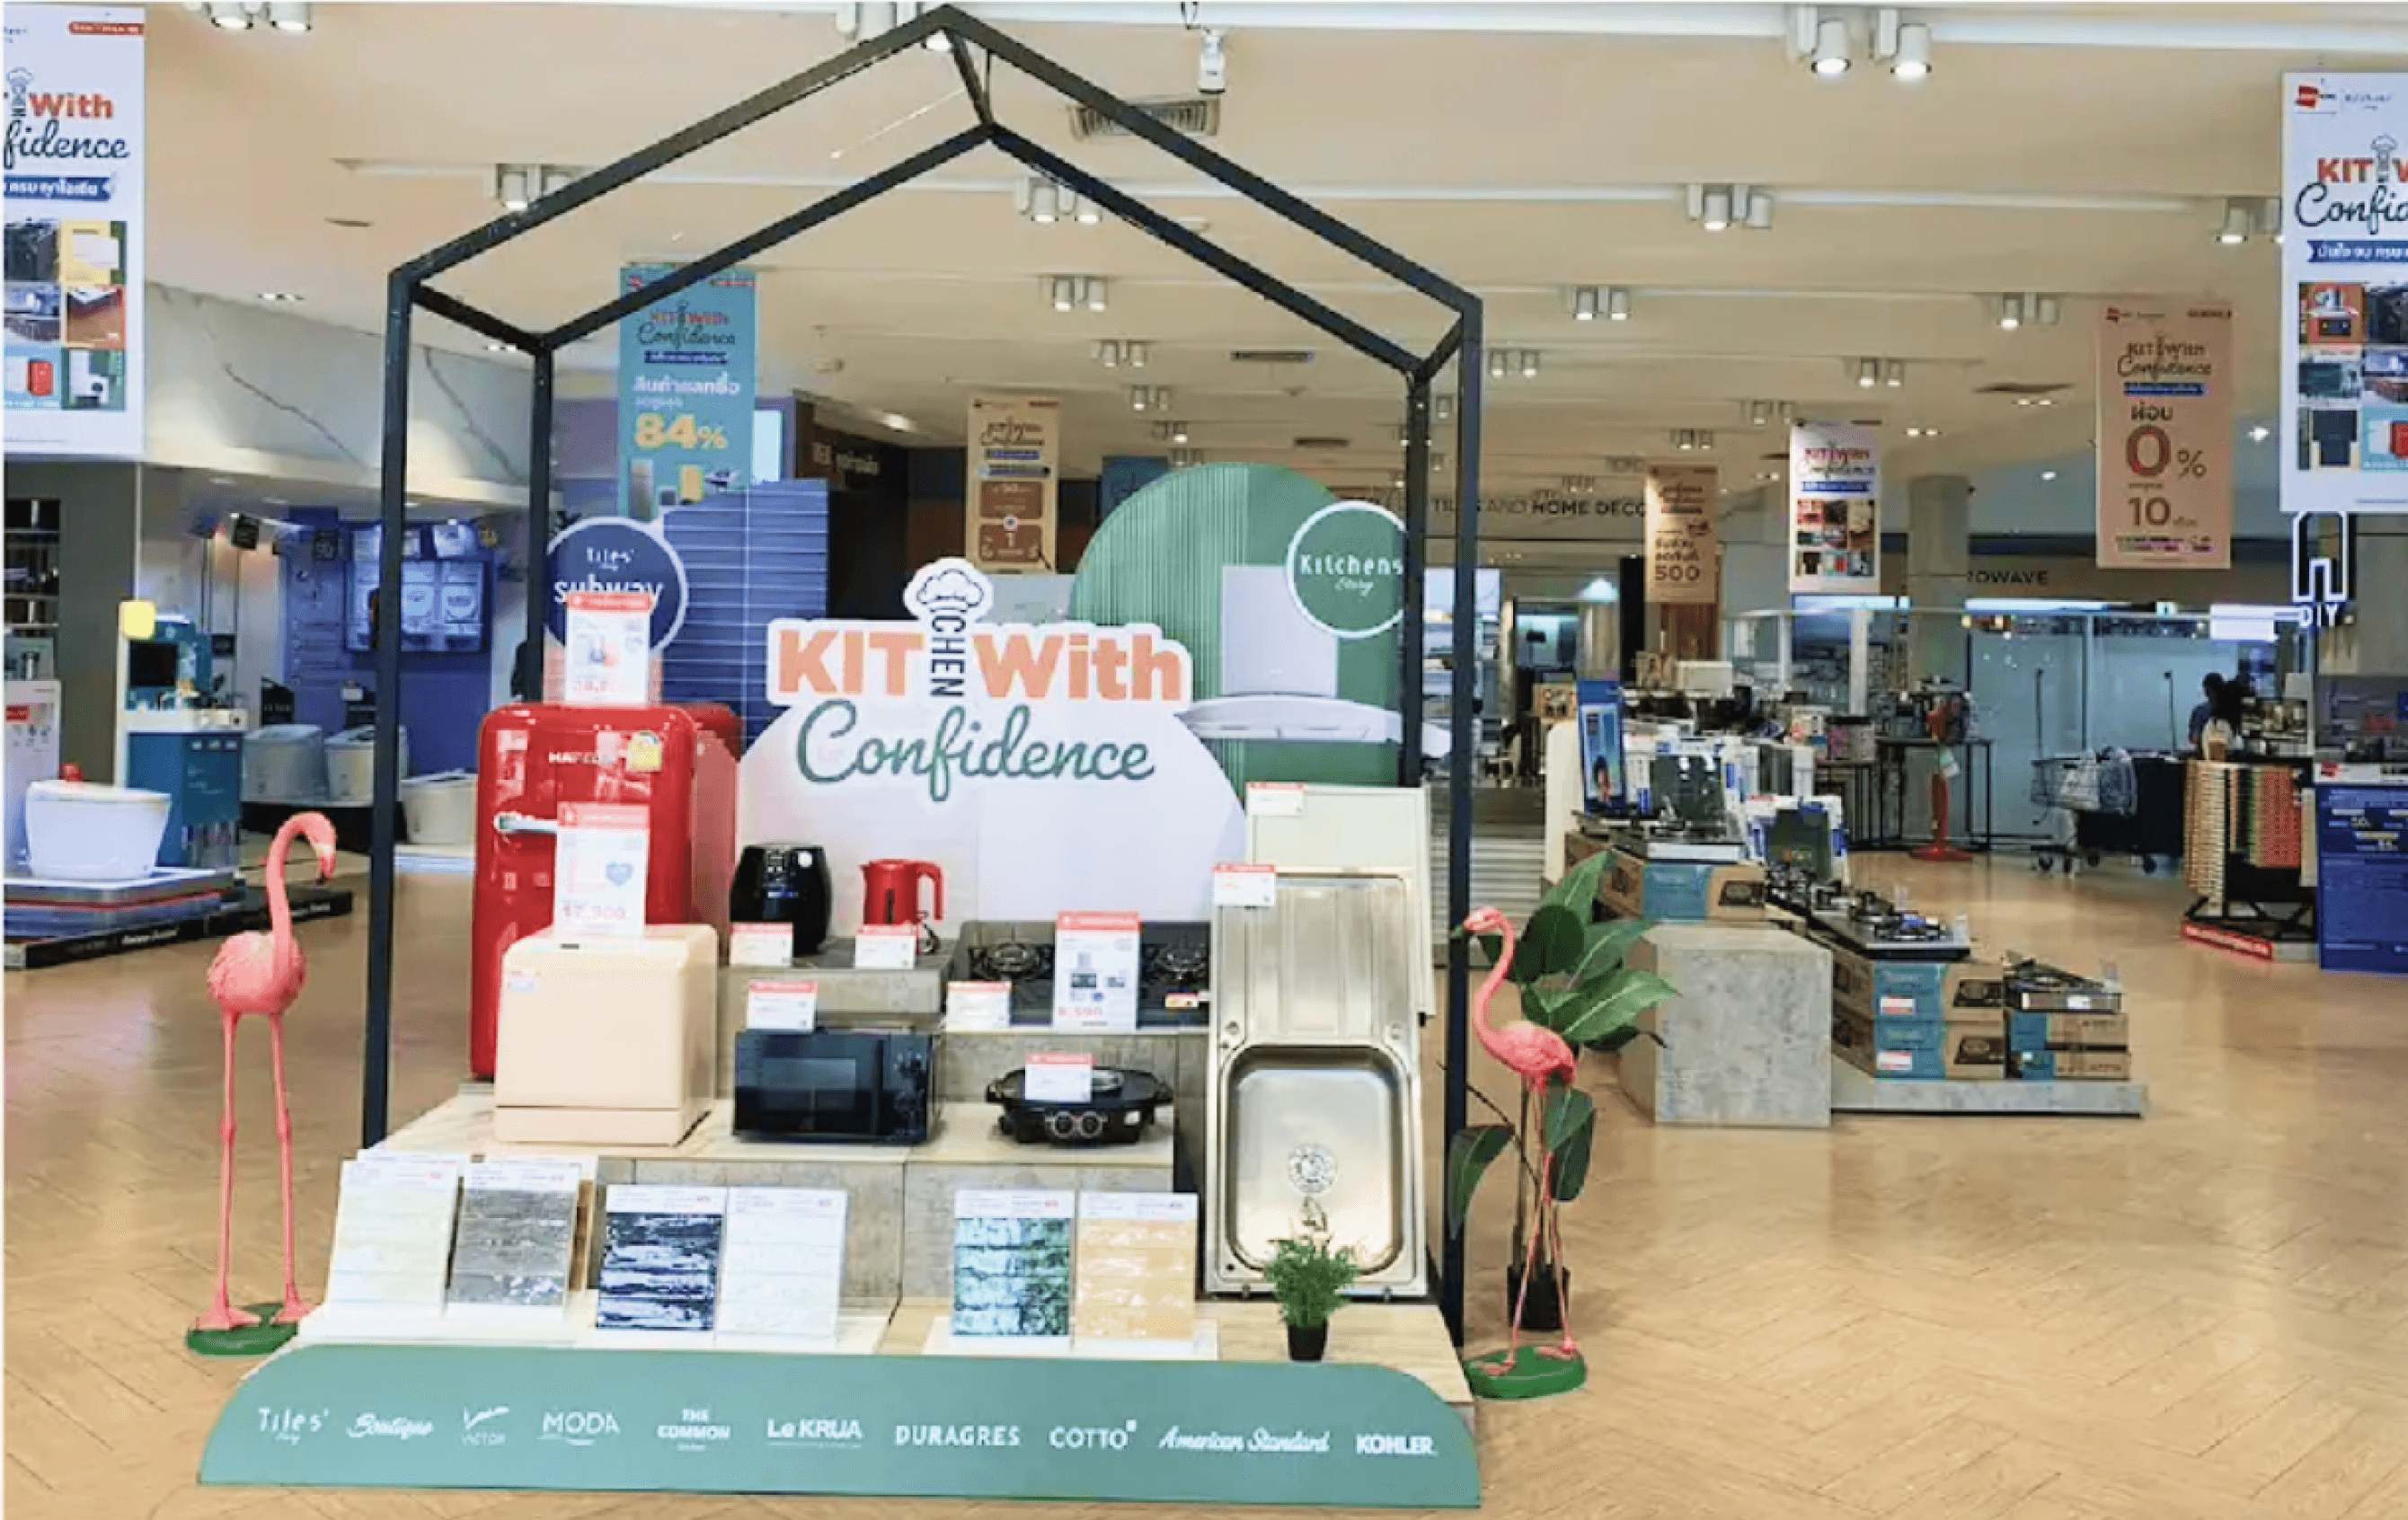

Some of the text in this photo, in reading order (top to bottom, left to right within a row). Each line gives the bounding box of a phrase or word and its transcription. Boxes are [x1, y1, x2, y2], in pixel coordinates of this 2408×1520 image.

[30, 93, 113, 118] With
[2317, 158, 2374, 183] KIT
[634, 413, 729, 449] 84%
[2127, 497, 2171, 526] 10
[1301, 554, 1403, 575] Kitchens
[1654, 565, 1700, 581] 500
[778, 629, 1183, 702] KIT With
[930, 614, 966, 698] CHEN
[797, 698, 1155, 802] Confidence
[542, 1411, 621, 1435] MODA
[657, 1425, 730, 1440] COMMON
[895, 1425, 1021, 1446] DURAGRES
[1049, 1426, 1129, 1449] COTTO
[1159, 1426, 1331, 1453] American Standard
[1356, 1432, 1438, 1455] KOHLER
